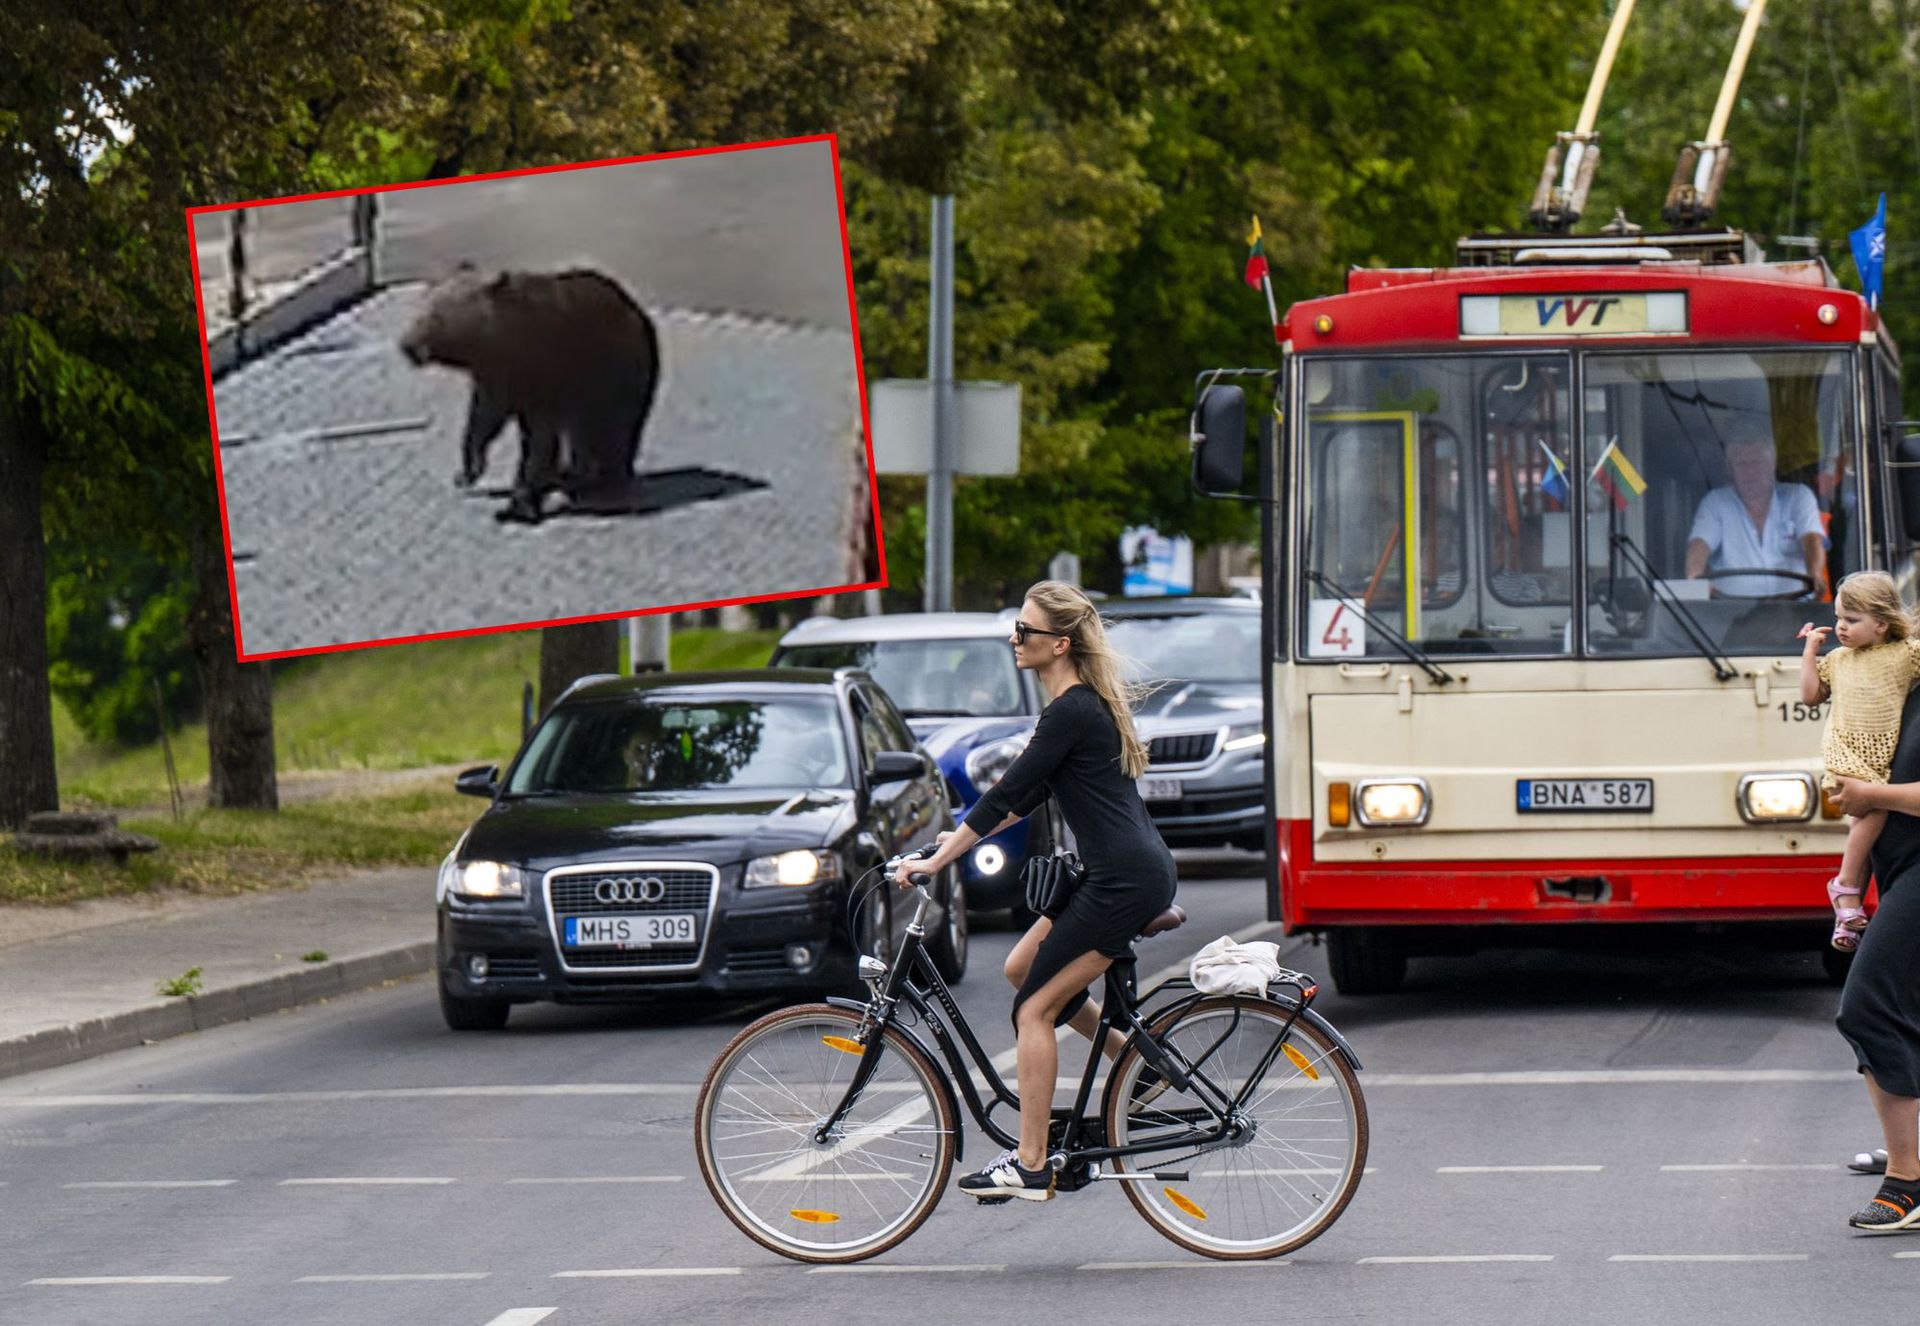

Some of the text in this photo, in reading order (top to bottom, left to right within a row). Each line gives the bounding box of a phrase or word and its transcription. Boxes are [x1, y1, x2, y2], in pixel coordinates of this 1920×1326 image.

[1536, 298, 1620, 326] VVT
[1322, 602, 1352, 651] 4
[1534, 783, 1585, 804] BNA
[1603, 783, 1646, 804] 587
[581, 919, 630, 941] MHS
[648, 918, 689, 939] 309
